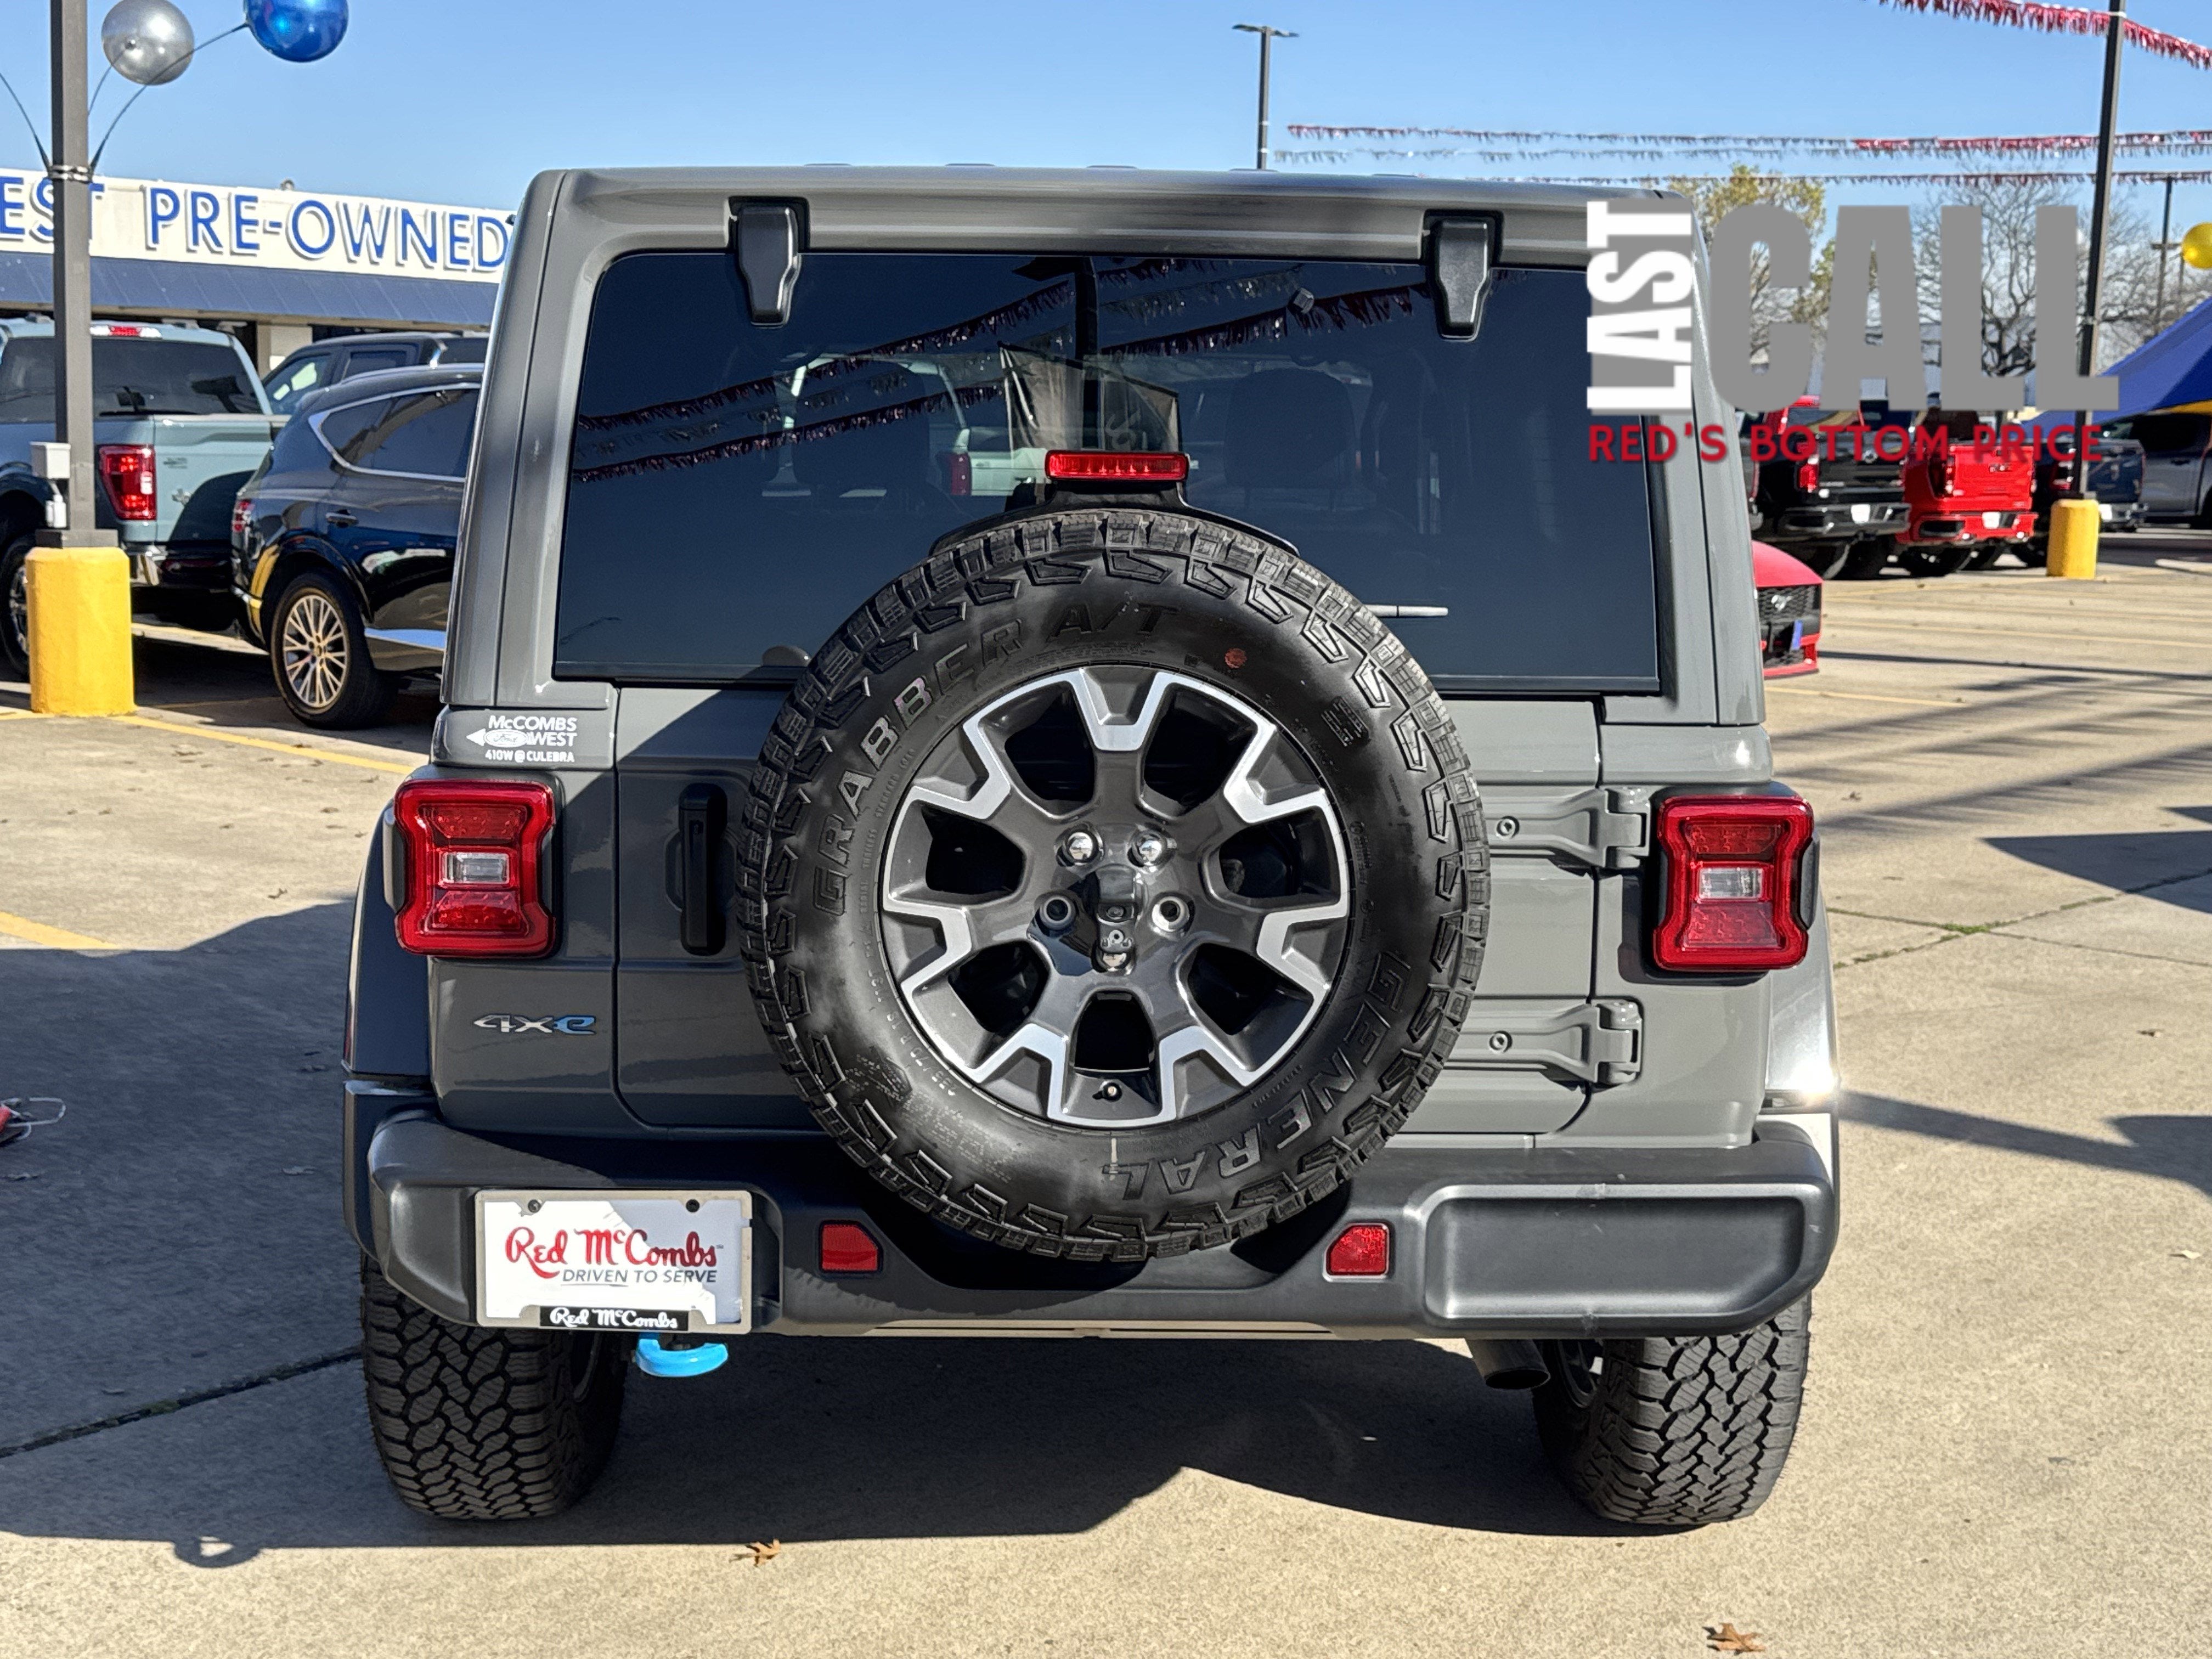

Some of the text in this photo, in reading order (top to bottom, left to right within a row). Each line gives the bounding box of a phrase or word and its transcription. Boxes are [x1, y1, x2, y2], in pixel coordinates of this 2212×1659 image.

[150, 187, 509, 268] PRE-OWNED
[489, 715, 578, 731] McCOMBS
[526, 732, 578, 746] WEST
[814, 619, 1022, 915] GRABBER
[1102, 950, 1410, 1200] GENERAL
[505, 1226, 716, 1279] Red McCombs
[562, 1269, 717, 1283] DRIVEN TO SERVE
[550, 1307, 678, 1328] Red McCombs
